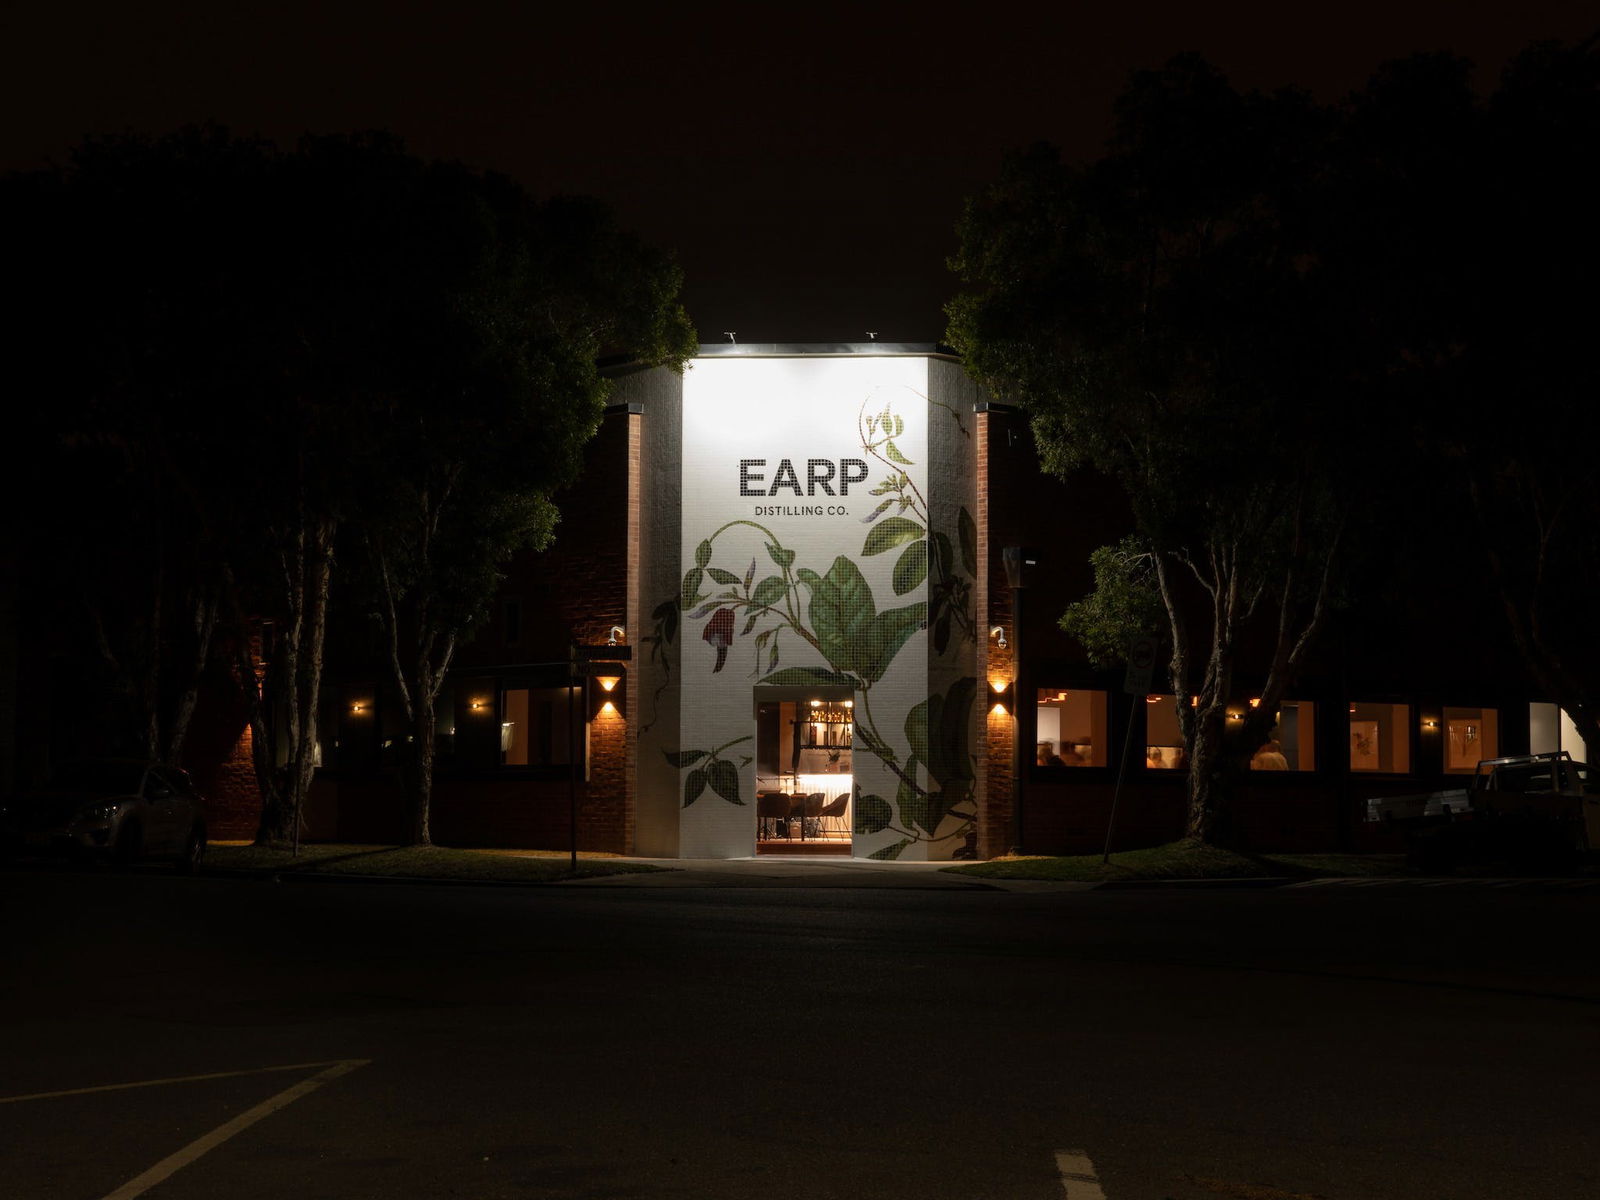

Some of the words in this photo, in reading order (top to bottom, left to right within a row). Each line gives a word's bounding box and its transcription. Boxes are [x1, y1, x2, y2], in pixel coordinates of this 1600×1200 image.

[740, 458, 869, 497] EARP
[755, 505, 823, 516] DISTILLING
[827, 505, 849, 516] CO.
